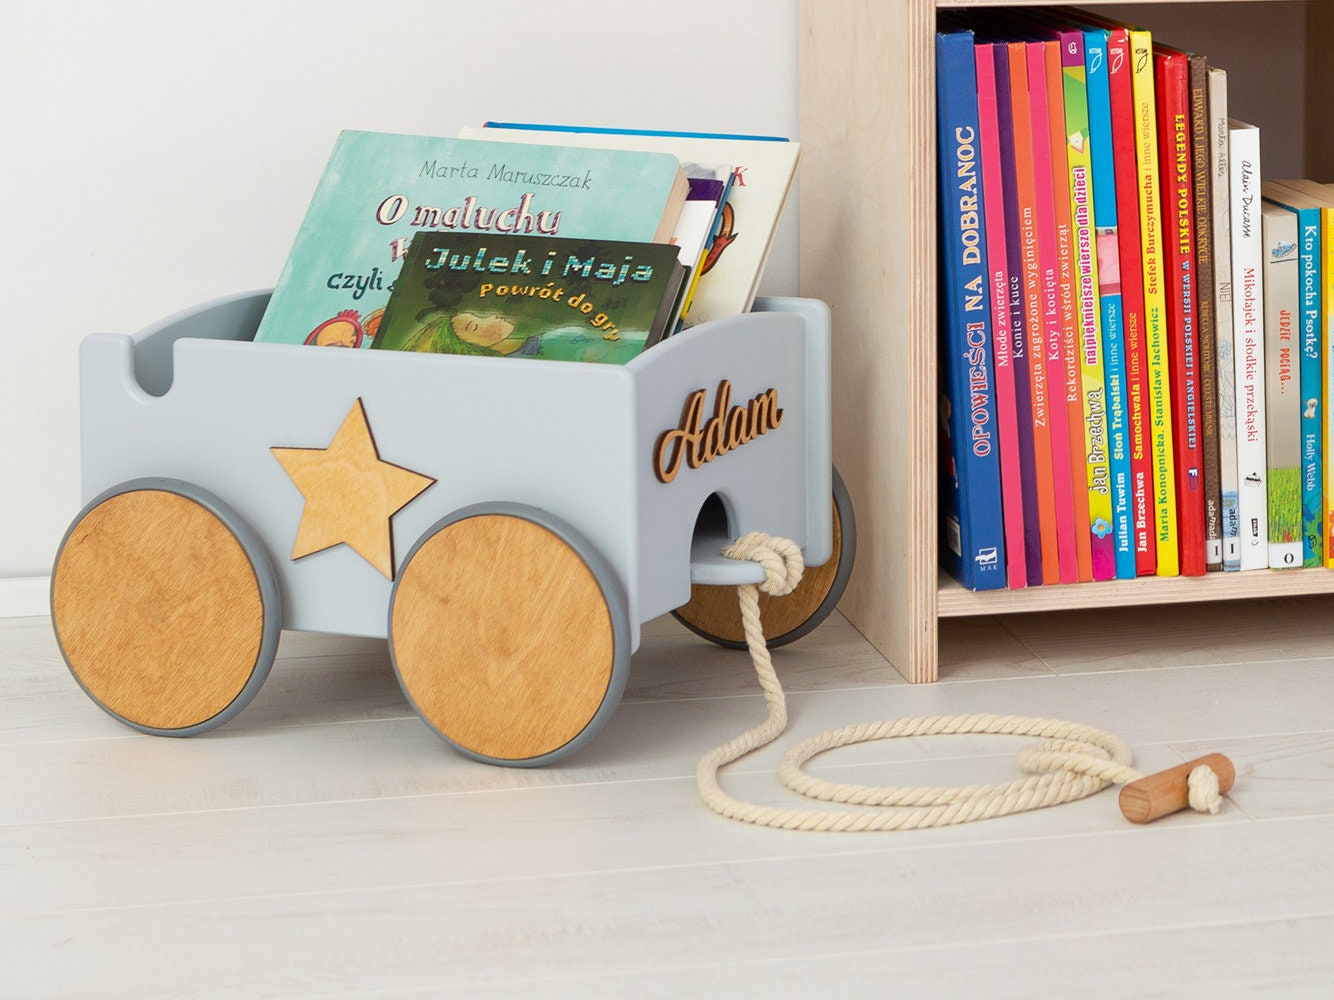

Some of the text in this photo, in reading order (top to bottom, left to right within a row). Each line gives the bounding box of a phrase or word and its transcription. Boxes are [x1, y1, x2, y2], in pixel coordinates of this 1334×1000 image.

[375, 191, 562, 236] O maluchu
[418, 159, 592, 190] Marta Maruszczak
[1193, 88, 1208, 265] EDWARD JEGO WIELKIE ODKRYCIE
[1242, 194, 1254, 239] Ducasse
[326, 267, 383, 300] czyli
[425, 247, 532, 276] Julek
[541, 251, 557, 276] i
[563, 255, 654, 287] Maja
[479, 282, 622, 342] Powrót do gry
[955, 126, 991, 457] OPOWIEŚCI NA DOBRANOC
[994, 270, 1009, 367] Młode zwierzęta
[1009, 275, 1023, 359] Konie kuce
[1021, 206, 1046, 428] Zwierzęta zagrożone wyginięciem
[1044, 268, 1060, 361] Koty kocięta
[1057, 223, 1078, 402] Rekordziści wśród zwierząt
[1072, 166, 1107, 465] Brzechwa najpiękniejsze wiersze dla dzieci
[1138, 102, 1170, 543] Maria Stanisław Jachowicz Stefek Burczymucha inne wiersze
[1175, 113, 1197, 450] LEGENDY POLSKIE W WERSJI POLSKIEJ ANGIELSKIEJ
[1243, 267, 1258, 443] Mikołajek słodkie przekąski
[653, 379, 784, 484] Adam
[1106, 302, 1130, 553] Julian Tuwim Słoń Trąbalski inne wiersze
[1127, 312, 1148, 553] Jan Brzechwa Samochwała inne wiersze
[1301, 225, 1318, 492] Kto pokocha Psotkę? Holly Webb
